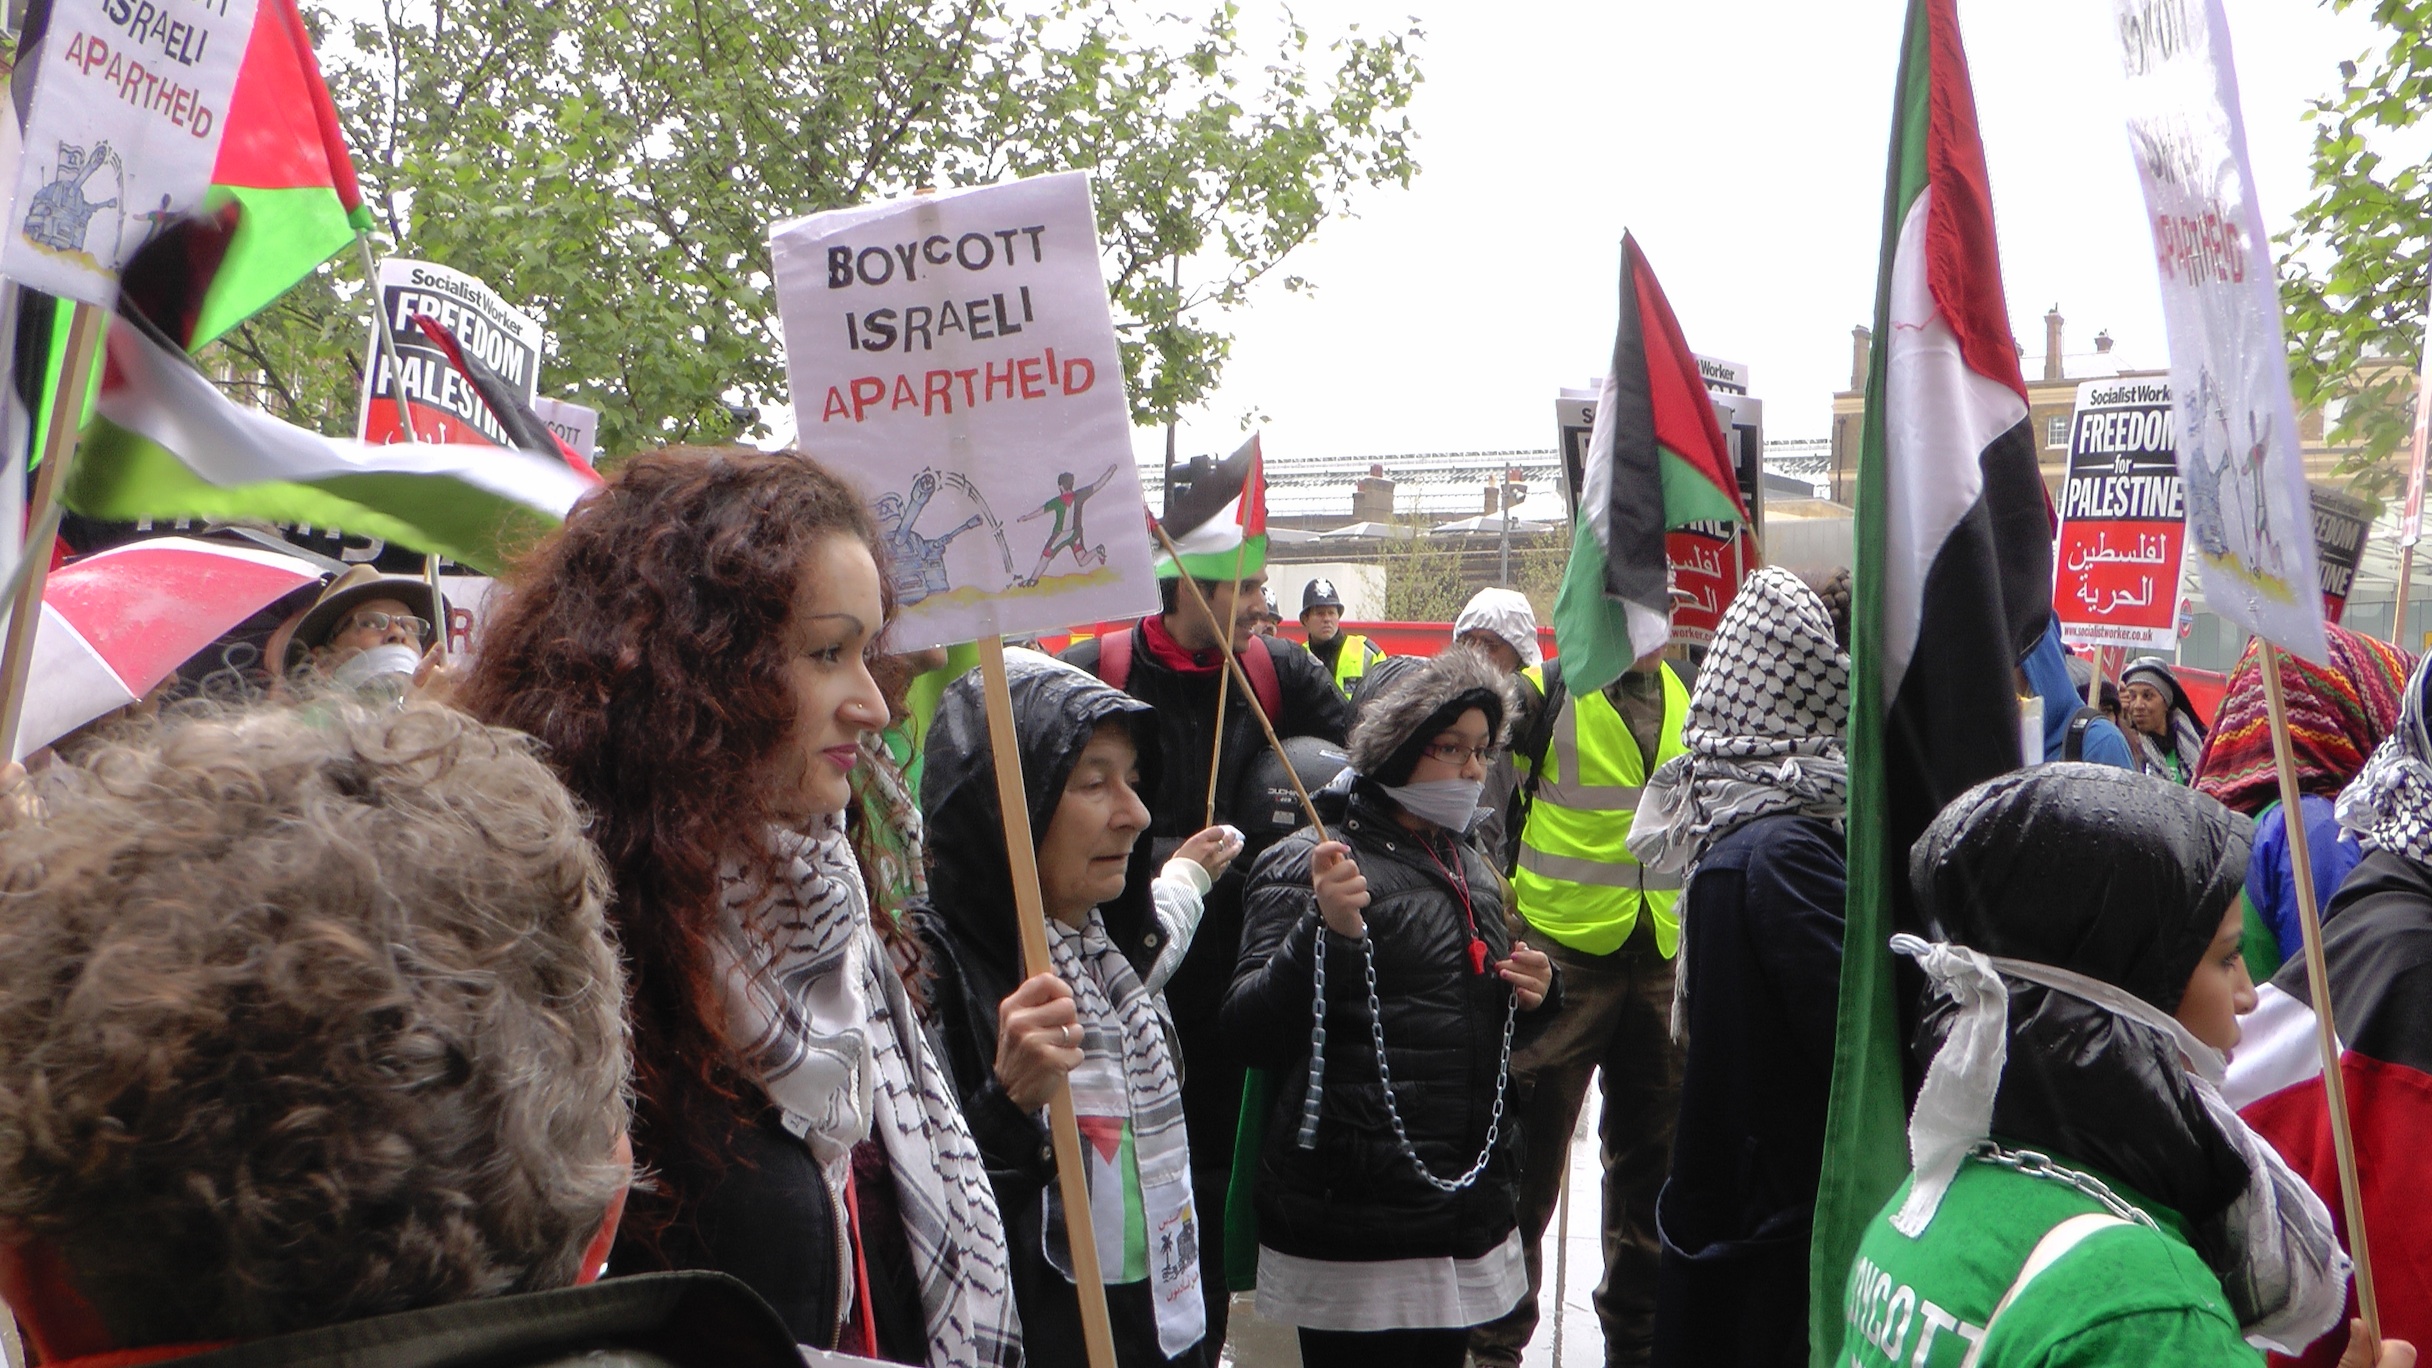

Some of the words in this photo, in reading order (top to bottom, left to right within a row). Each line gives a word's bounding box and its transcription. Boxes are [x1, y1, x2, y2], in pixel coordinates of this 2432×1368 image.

[65, 31, 213, 139] APARTHEID
[828, 225, 1045, 290] BOYCOTT
[395, 291, 525, 387] FREEDOM
[846, 286, 1034, 352] ISRAELI
[822, 347, 1097, 423] APARTHEID
[2114, 453, 2133, 475] for
[2067, 475, 2184, 518] PALESTINE
[2067, 531, 2167, 571] لفلسطين
[2076, 573, 2154, 614] الحرية
[2064, 623, 2153, 642] www.socialistworker.co.uk
